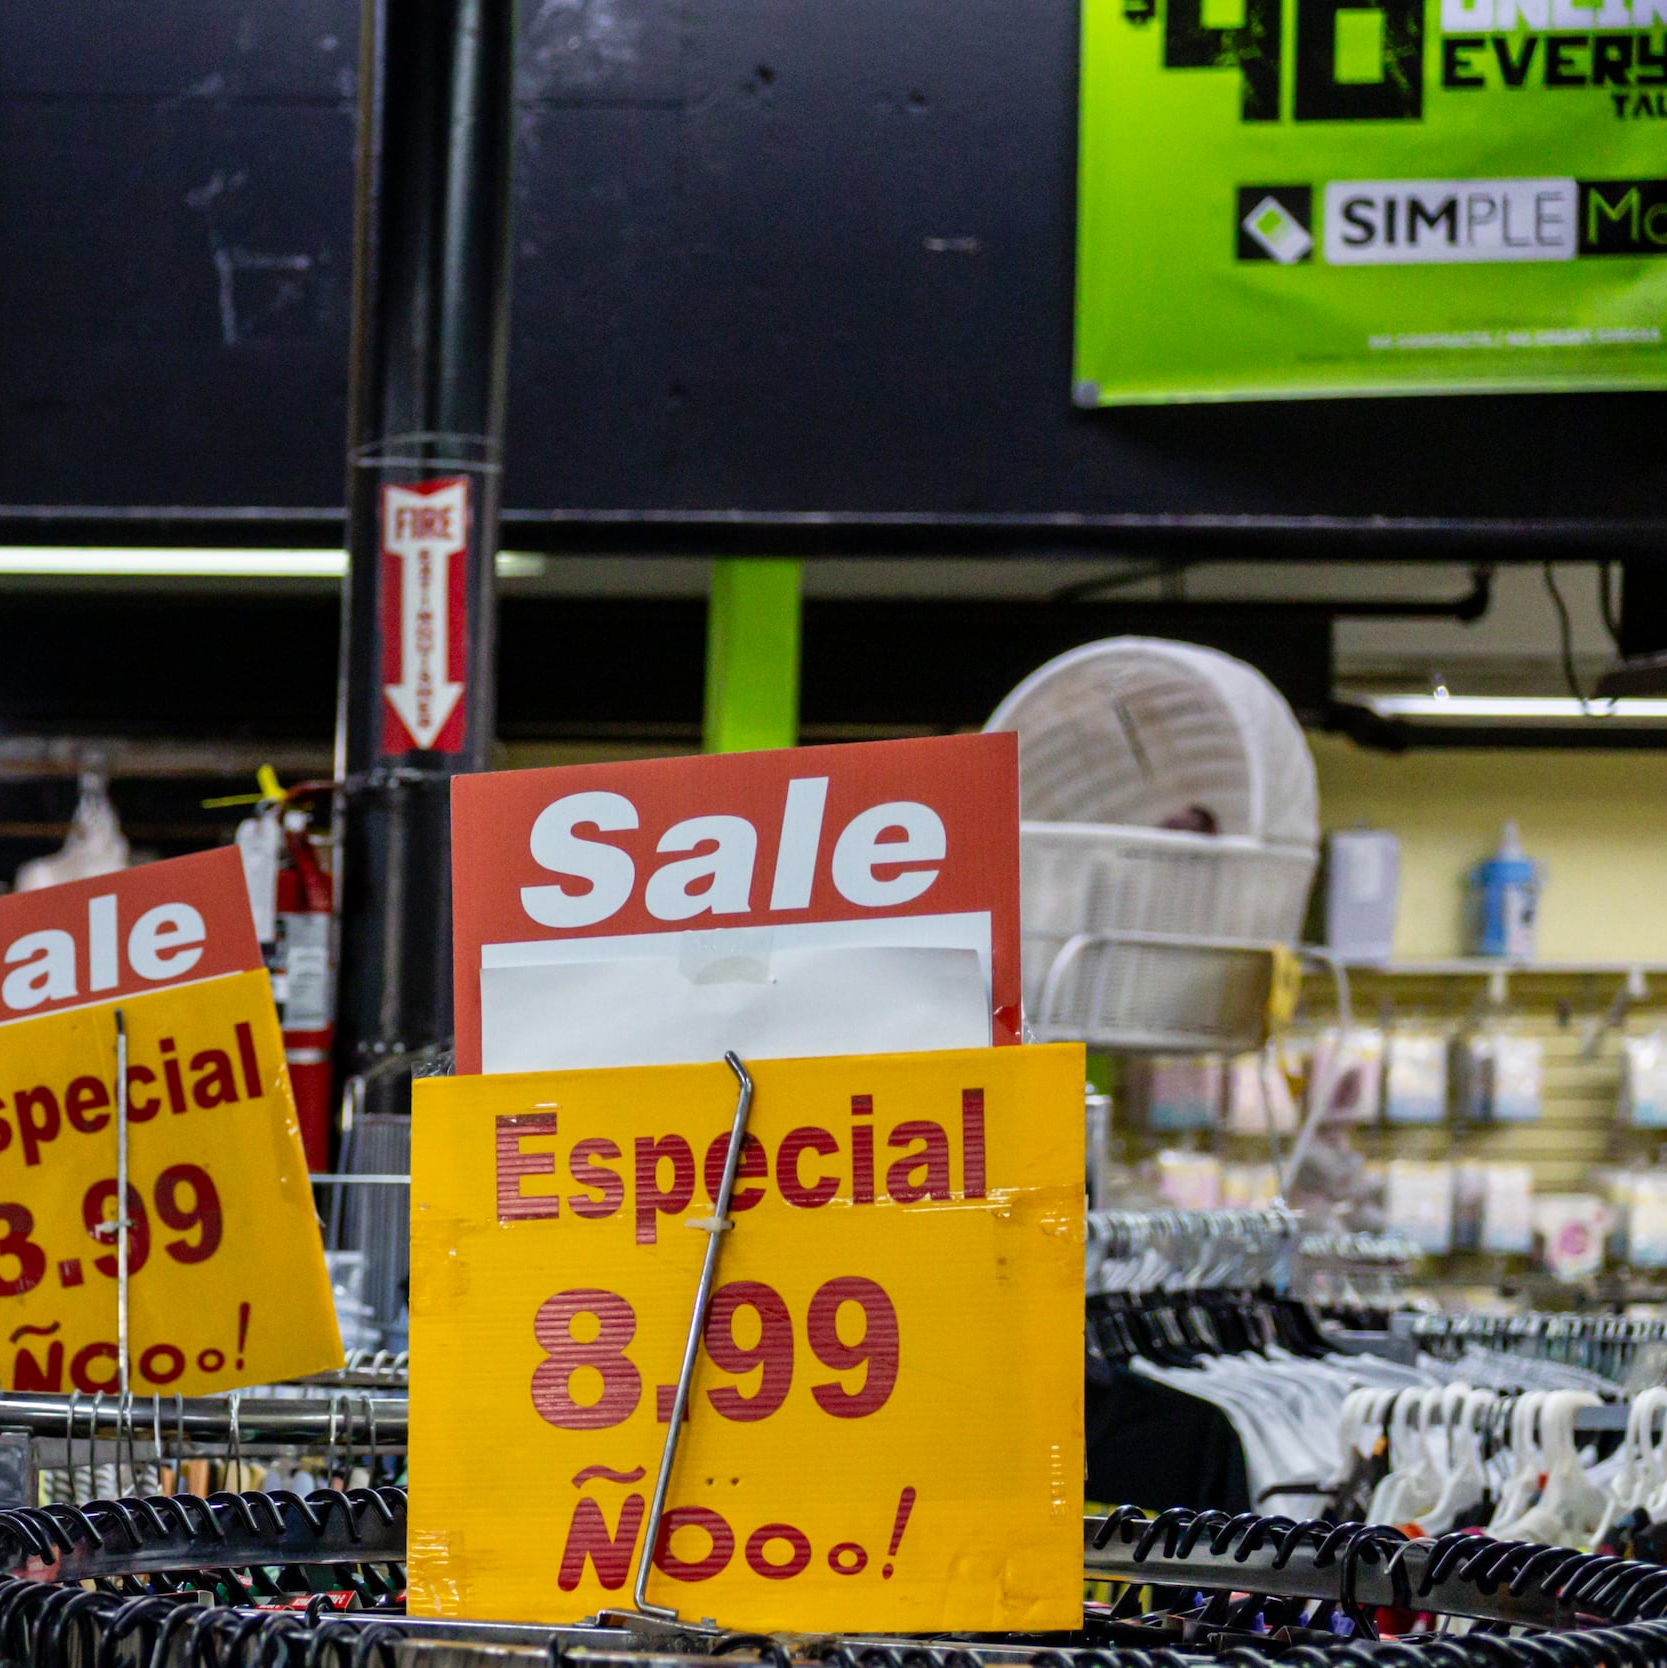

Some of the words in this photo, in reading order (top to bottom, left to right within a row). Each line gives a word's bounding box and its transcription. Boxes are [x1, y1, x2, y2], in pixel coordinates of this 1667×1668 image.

[1339, 190, 1565, 248] SIMPLE
[395, 505, 453, 541] FIRE
[519, 775, 948, 929] Sale
[494, 1086, 988, 1246] Especial
[529, 1275, 902, 1431] 8.99
